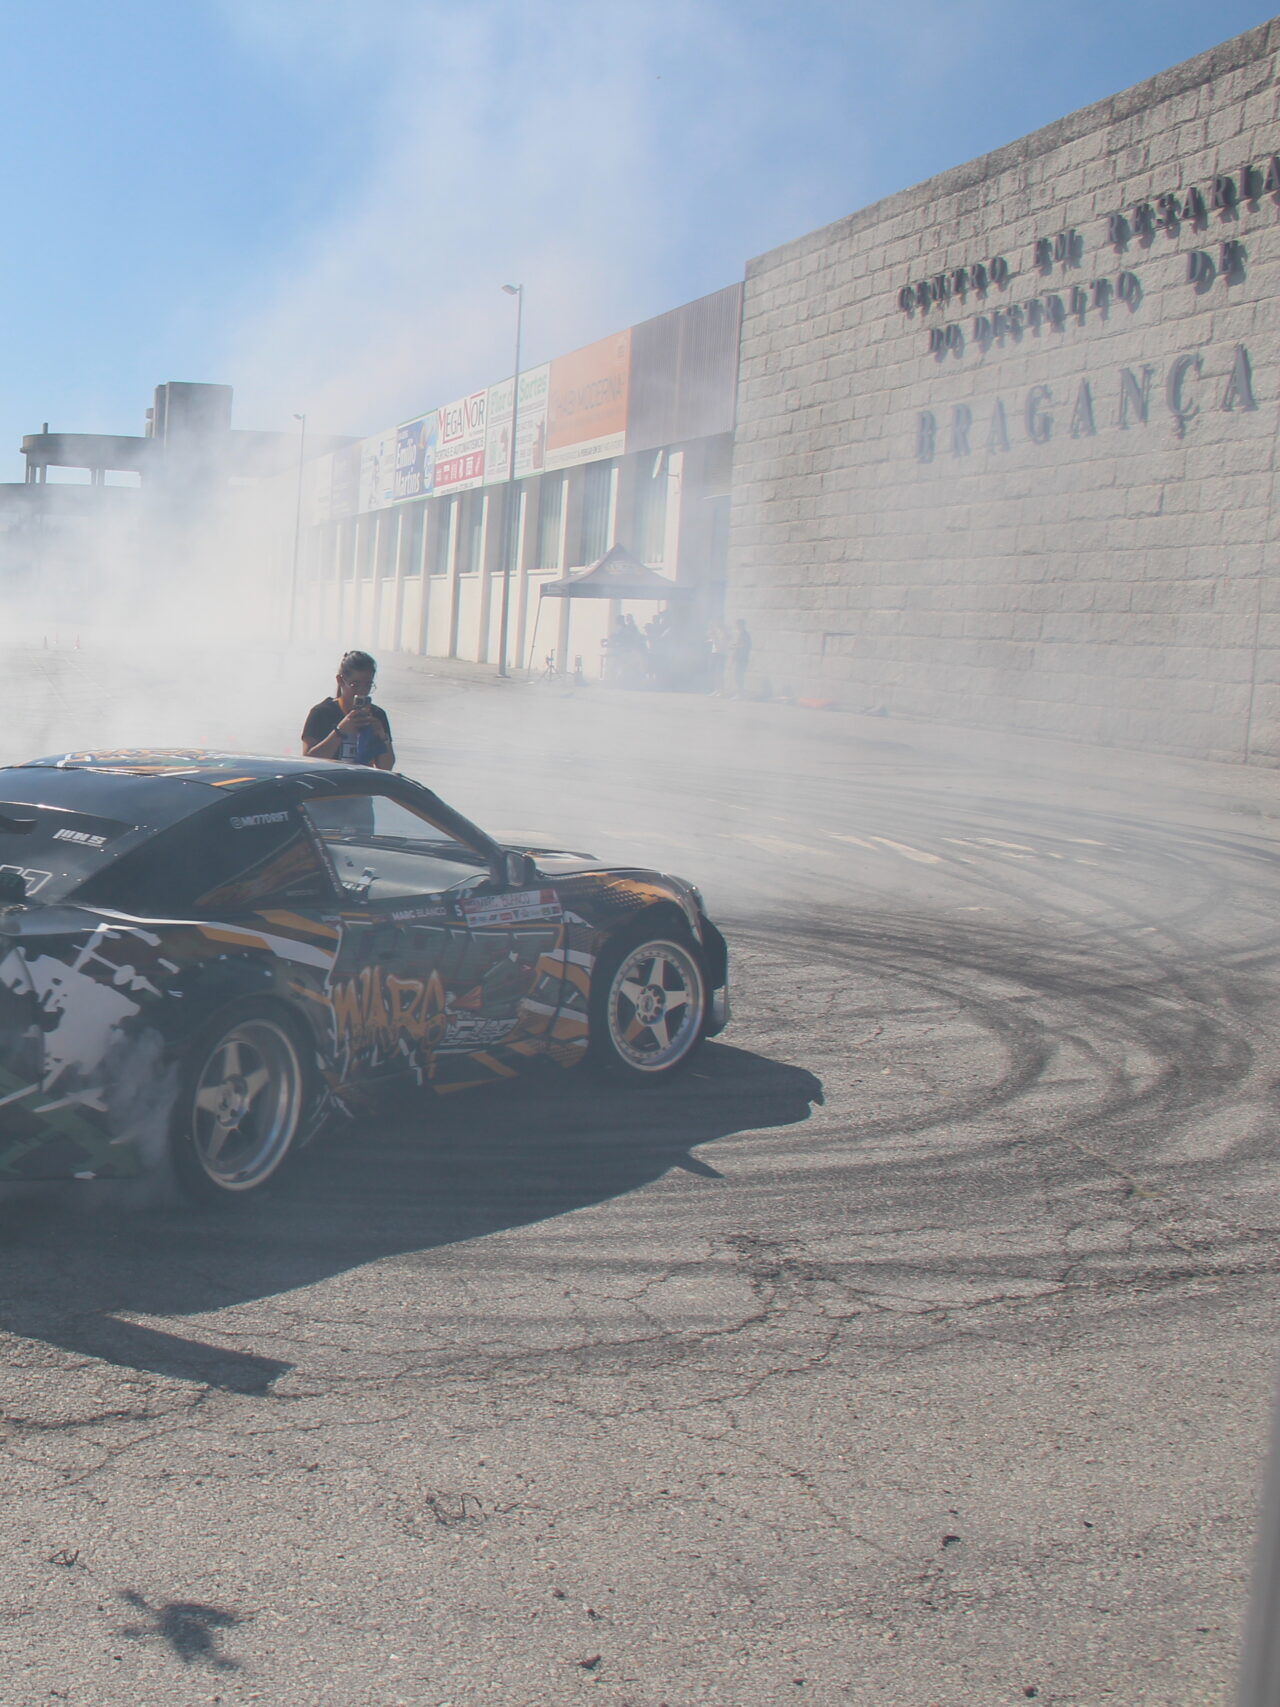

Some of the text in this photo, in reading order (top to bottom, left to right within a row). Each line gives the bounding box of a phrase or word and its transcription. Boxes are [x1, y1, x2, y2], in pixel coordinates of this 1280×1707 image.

[898, 256, 1009, 312] CENTRO
[928, 240, 1241, 354] DO DISTRITO DE
[916, 342, 1258, 464] BRAGANÇA
